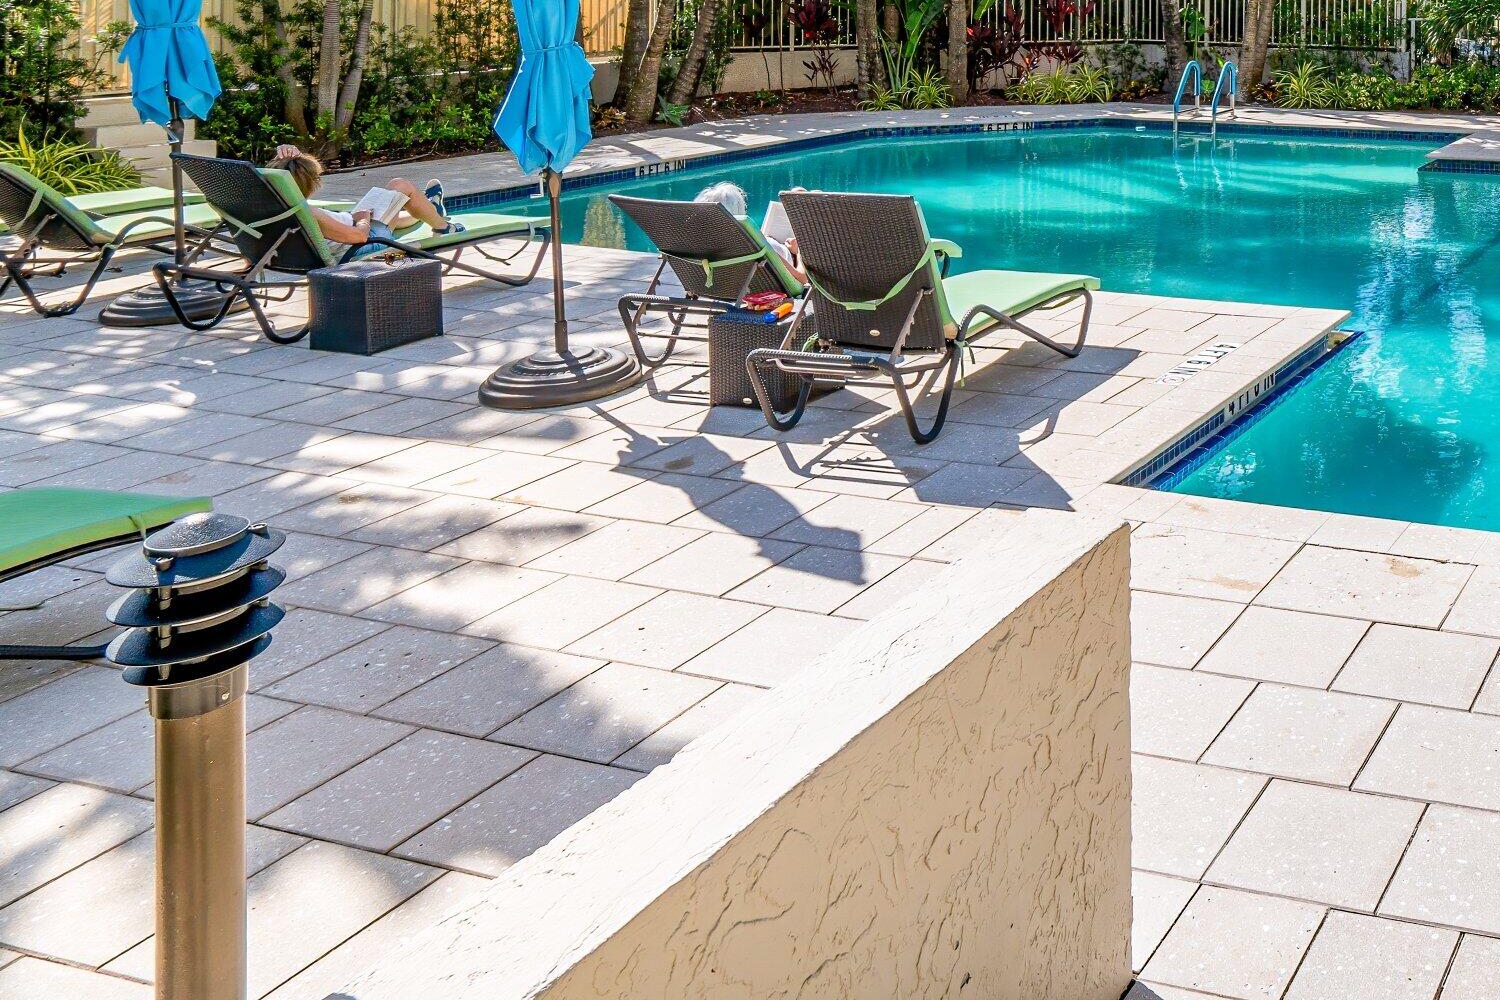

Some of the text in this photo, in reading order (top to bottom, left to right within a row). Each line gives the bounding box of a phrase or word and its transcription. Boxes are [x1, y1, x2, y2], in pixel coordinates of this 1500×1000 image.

[996, 122, 1009, 131] FT
[1022, 121, 1033, 131] IN
[649, 163, 660, 174] FT
[674, 159, 685, 172] IN
